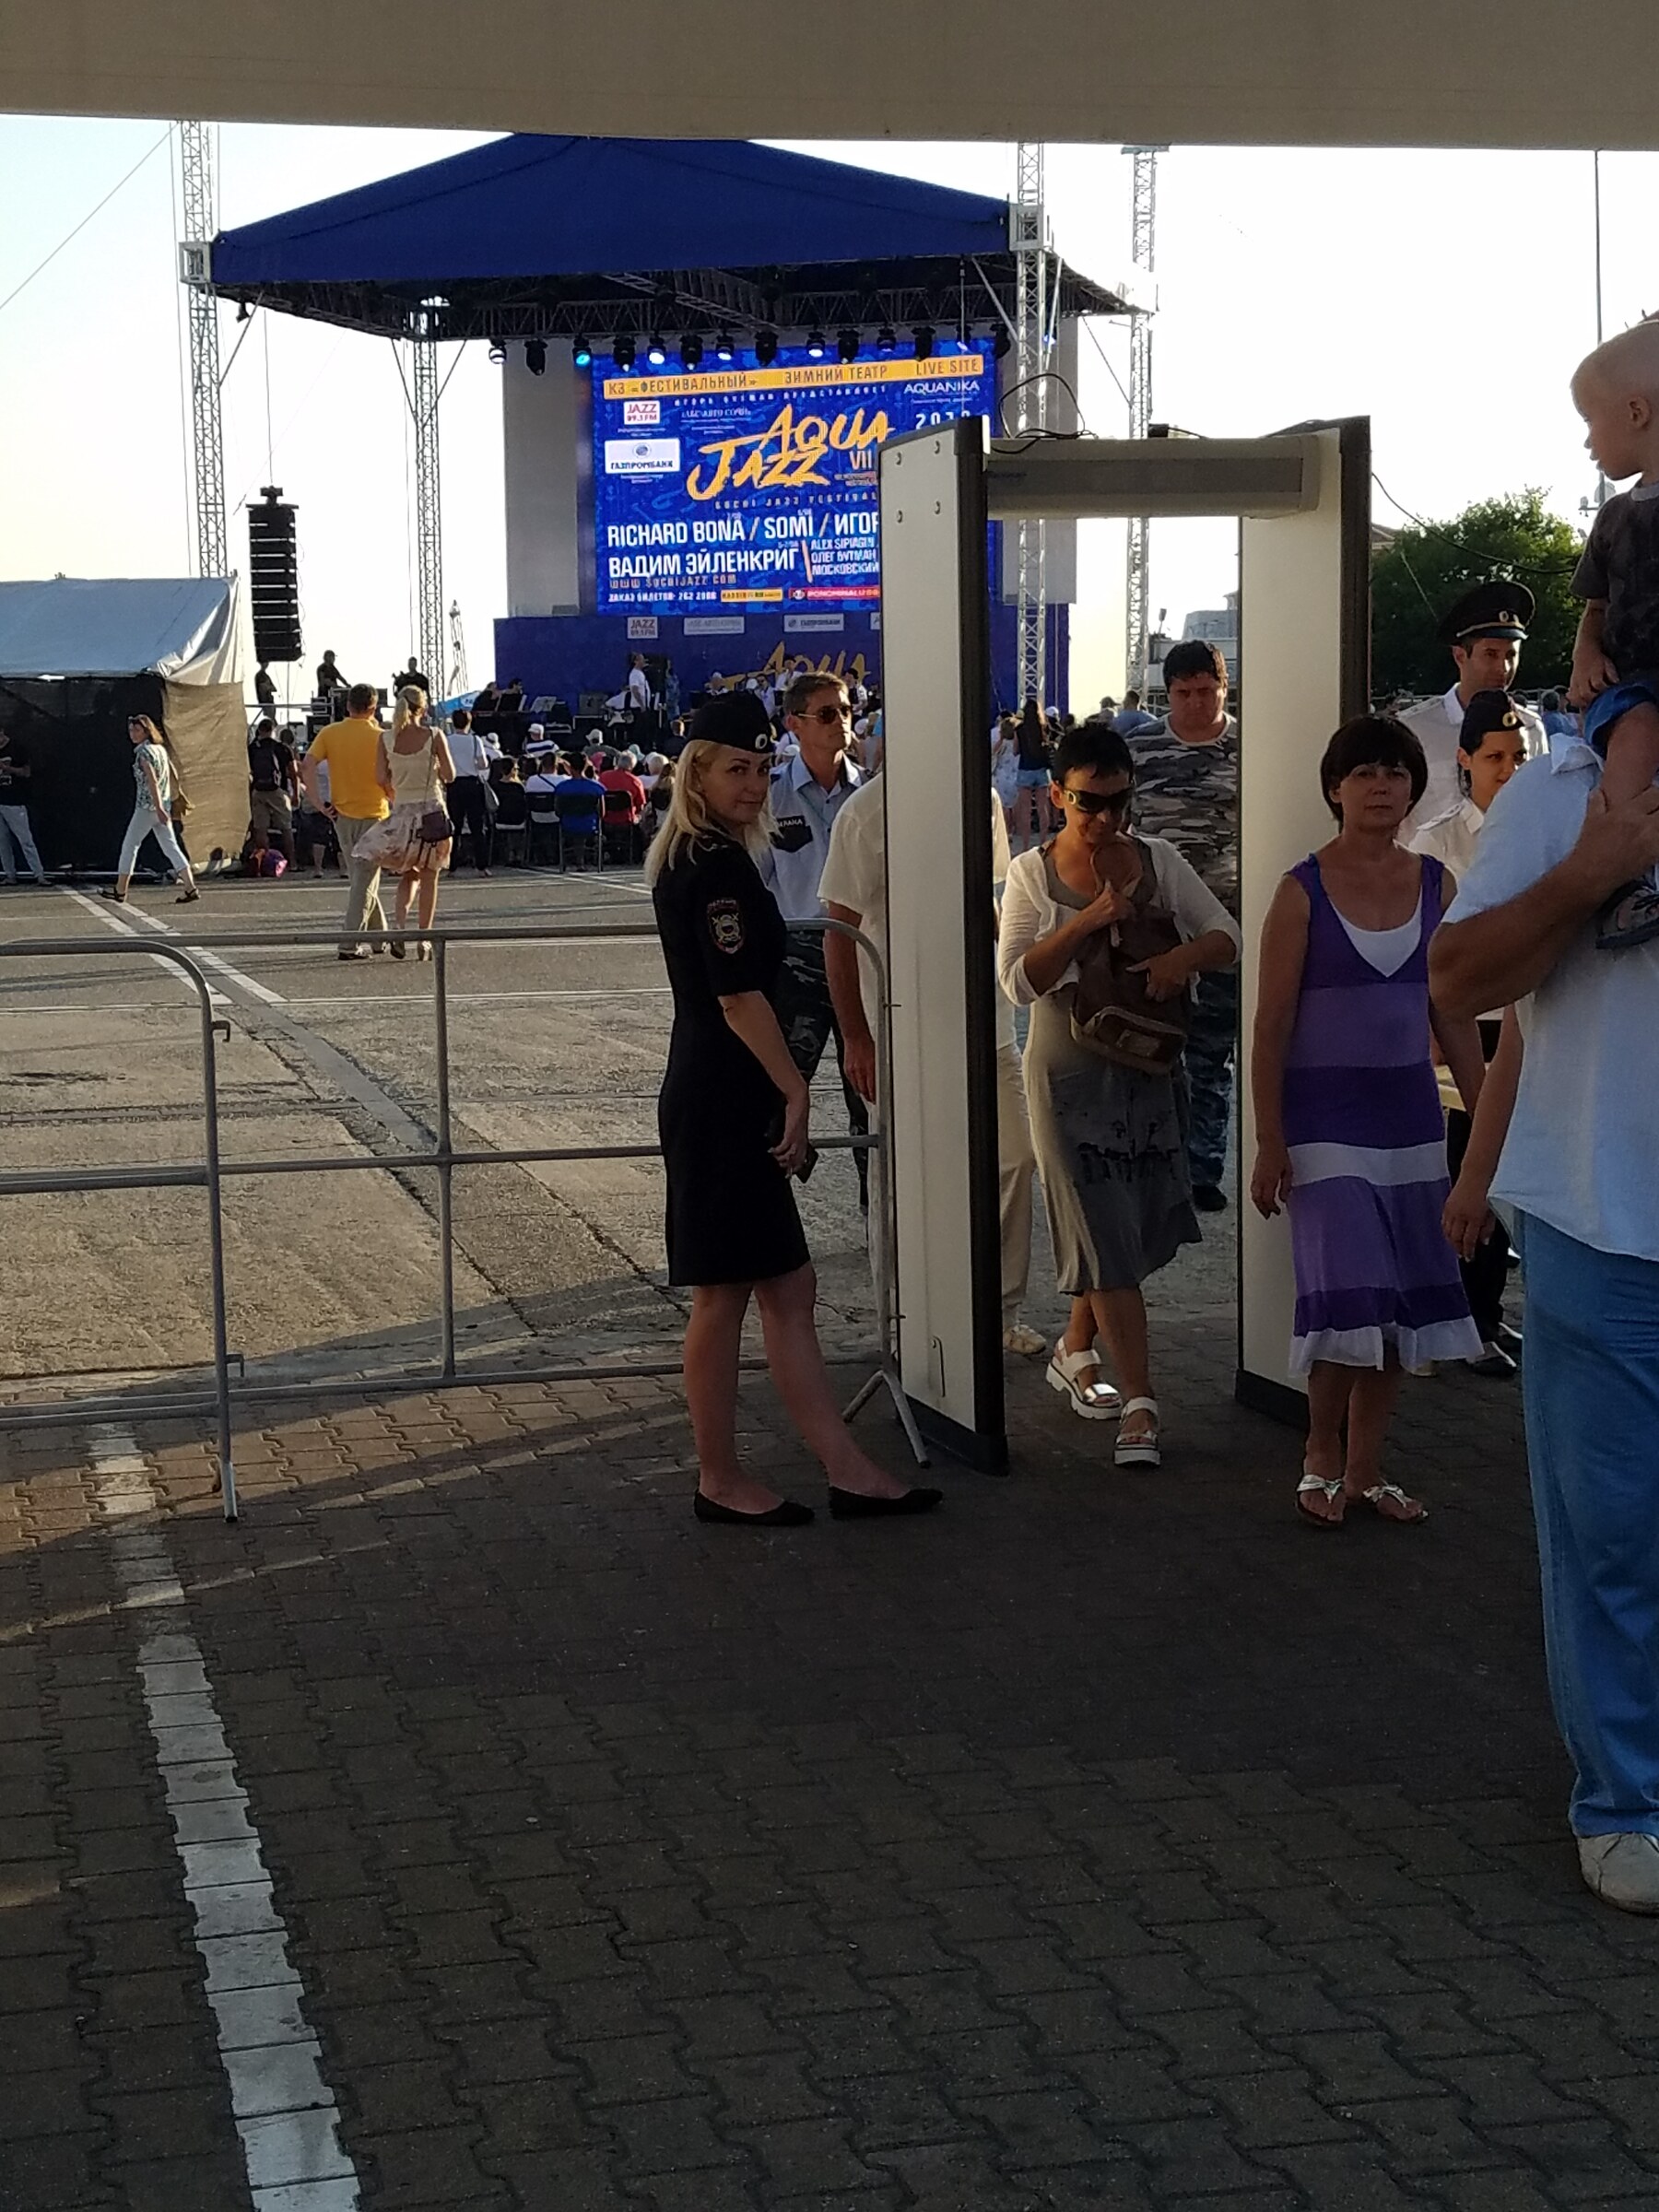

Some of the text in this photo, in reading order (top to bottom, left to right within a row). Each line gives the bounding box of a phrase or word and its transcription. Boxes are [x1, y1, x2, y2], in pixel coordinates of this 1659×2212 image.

[915, 359, 979, 376] LIVE SITE
[784, 365, 844, 384] ЗИМНИЙ
[850, 365, 888, 381] ТЕАТР
[903, 381, 980, 394] AQUANIKA
[627, 403, 657, 414] JAZZ
[610, 460, 674, 471] ГАЗПРОМБАНК
[607, 521, 688, 547] RICHARD
[692, 519, 746, 544] BONA
[763, 515, 814, 539] SOMI
[811, 538, 833, 550] ALEX
[608, 547, 799, 579] ВАДИМ ЭЙЛЕНКРИГ
[811, 550, 835, 563] ОЛЕГ
[631, 618, 655, 629] JAZZ
